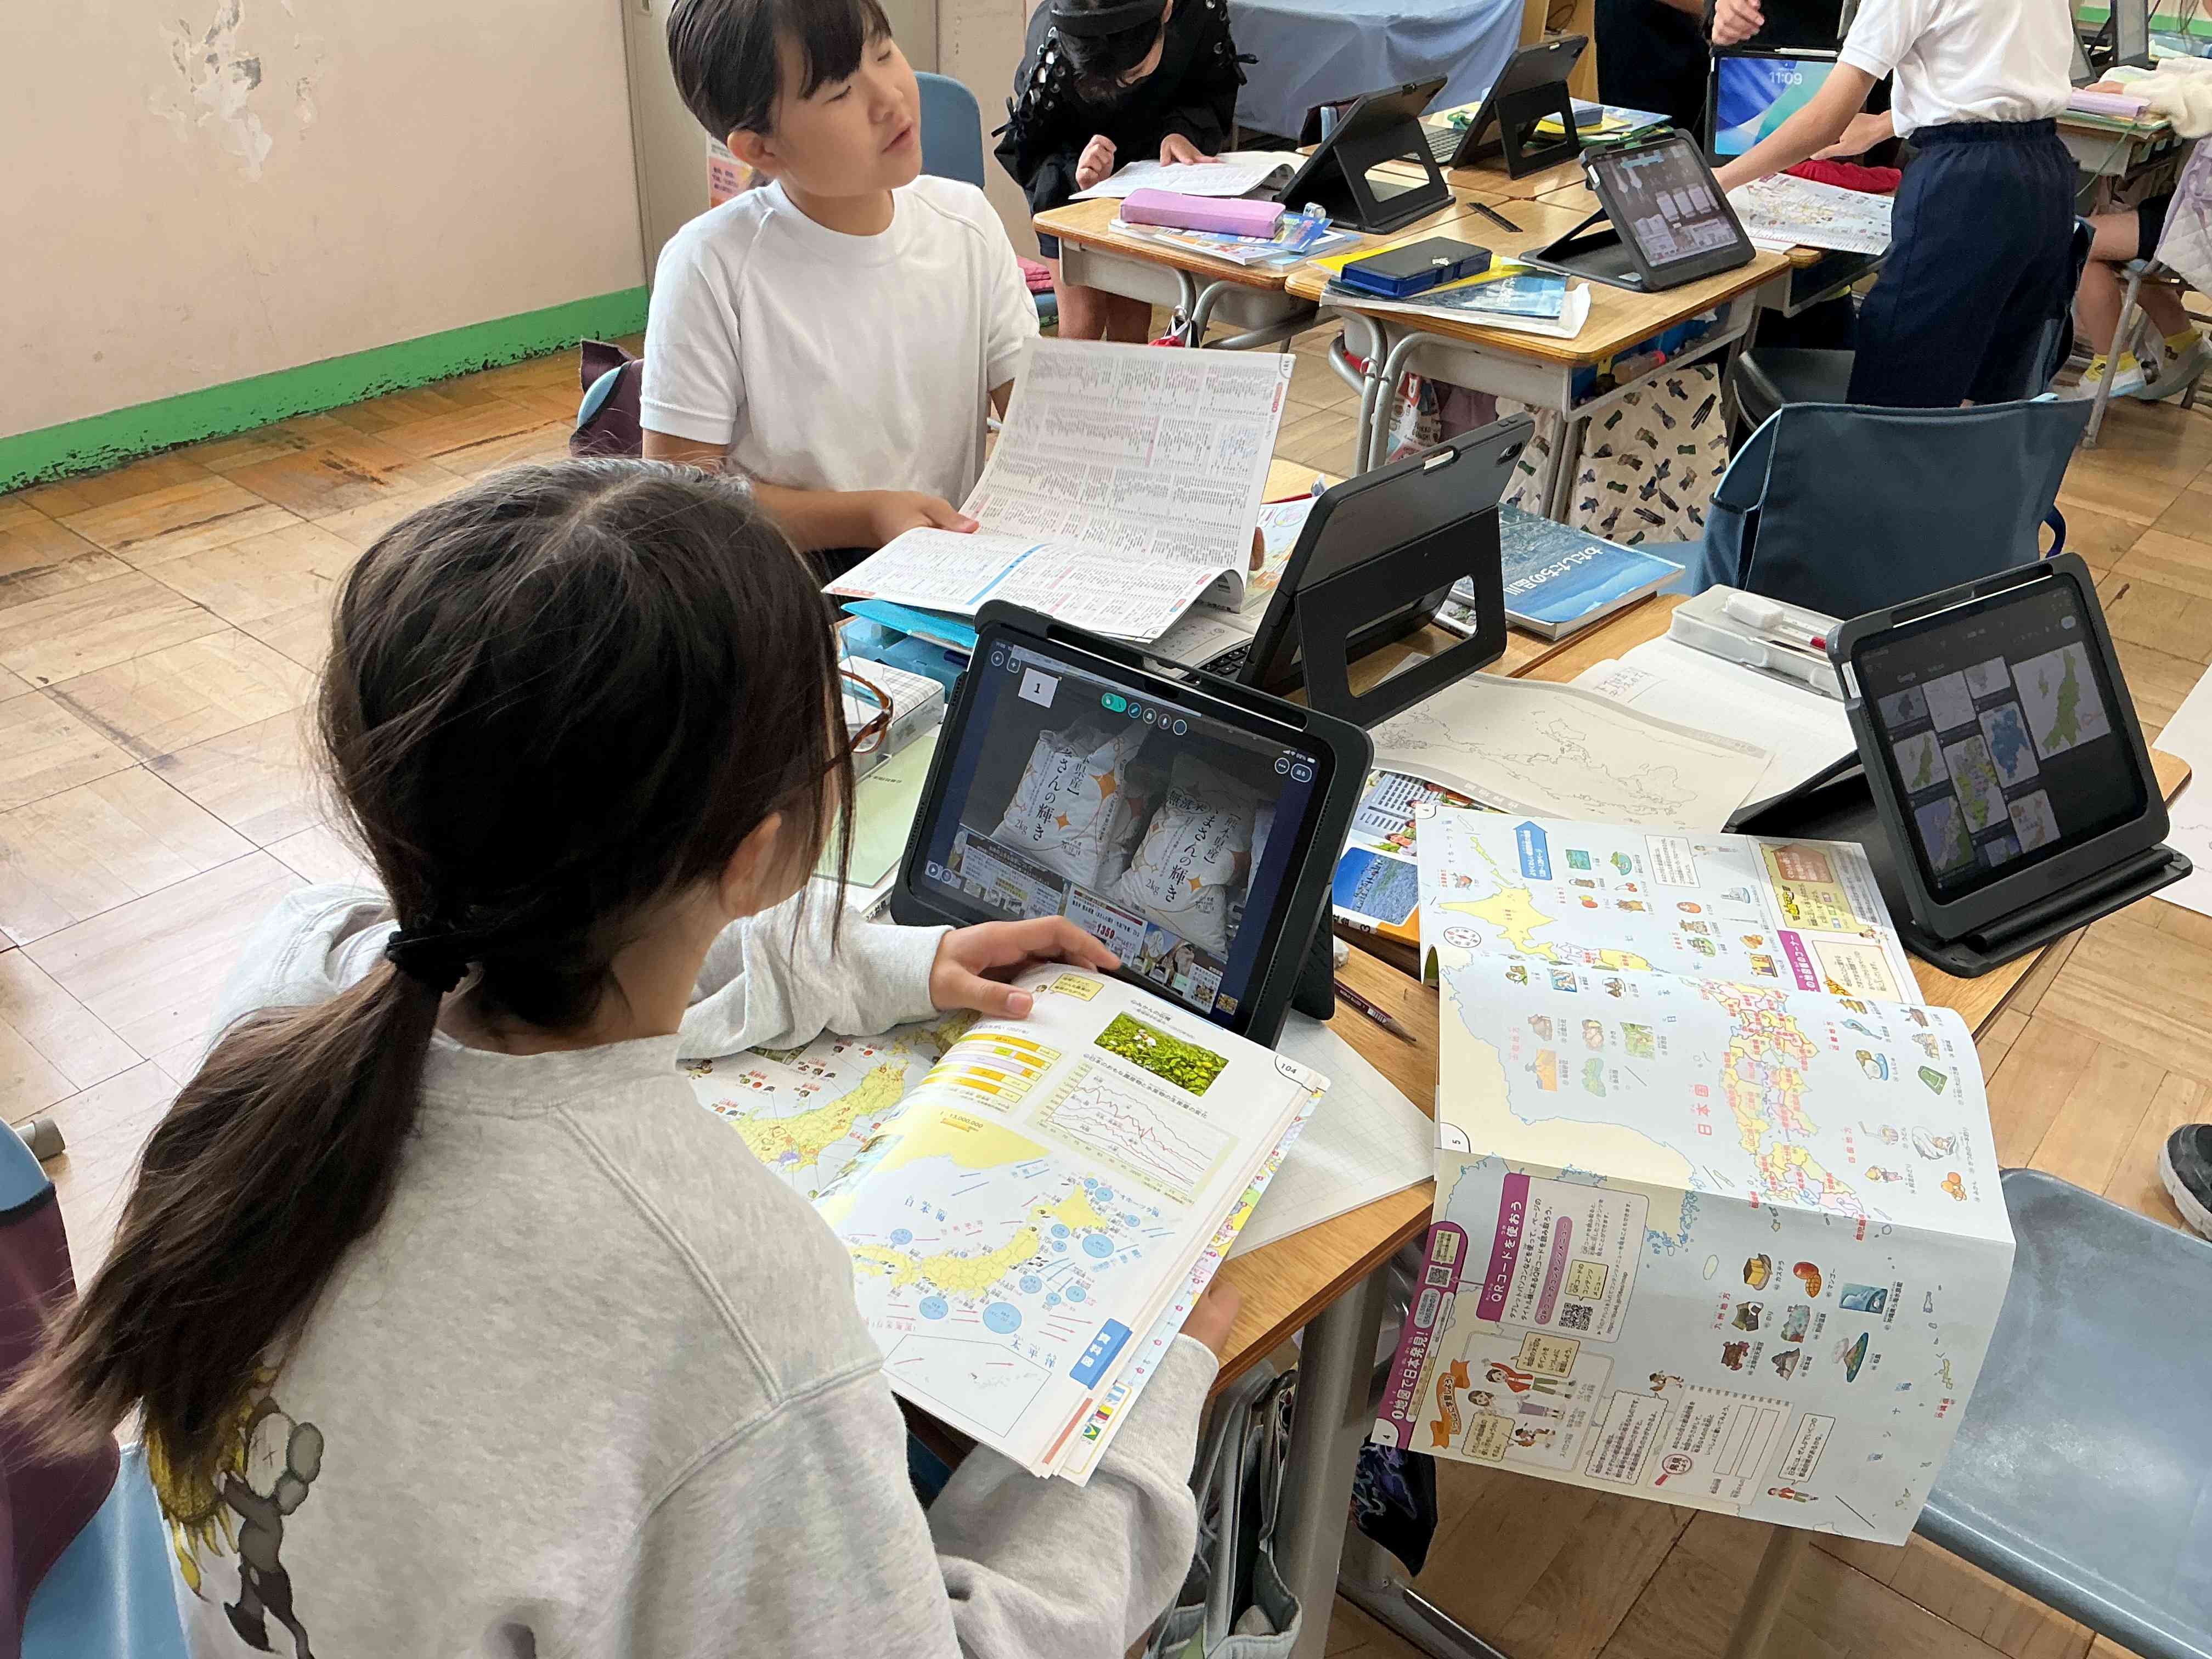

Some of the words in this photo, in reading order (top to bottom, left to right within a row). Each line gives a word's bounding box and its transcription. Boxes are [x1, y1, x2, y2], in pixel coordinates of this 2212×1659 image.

[1769, 71, 1803, 85] 11:09
[1034, 683, 1041, 693] 1
[1014, 820, 1028, 835] 2kg
[1146, 878, 1160, 895] 2kg
[1097, 923, 1115, 940] 1359
[1280, 1062, 1297, 1075] 104
[905, 1198, 946, 1222] 日本海
[1491, 1200, 1522, 1302] QRコードを使おう
[1509, 1198, 1542, 1319] タブレットパソコンなどを使って、ページの
[1539, 1221, 1568, 1321] QRコードのコンテンツメニュー
[1572, 1263, 1584, 1294] QRコードの
[1582, 1268, 1593, 1295] コンテンツ
[1775, 1260, 1785, 1283] カステラ
[1826, 1268, 1836, 1290] マンゴー
[1592, 1275, 1602, 1297] メニュー
[1714, 1292, 1731, 1330] 九州地方
